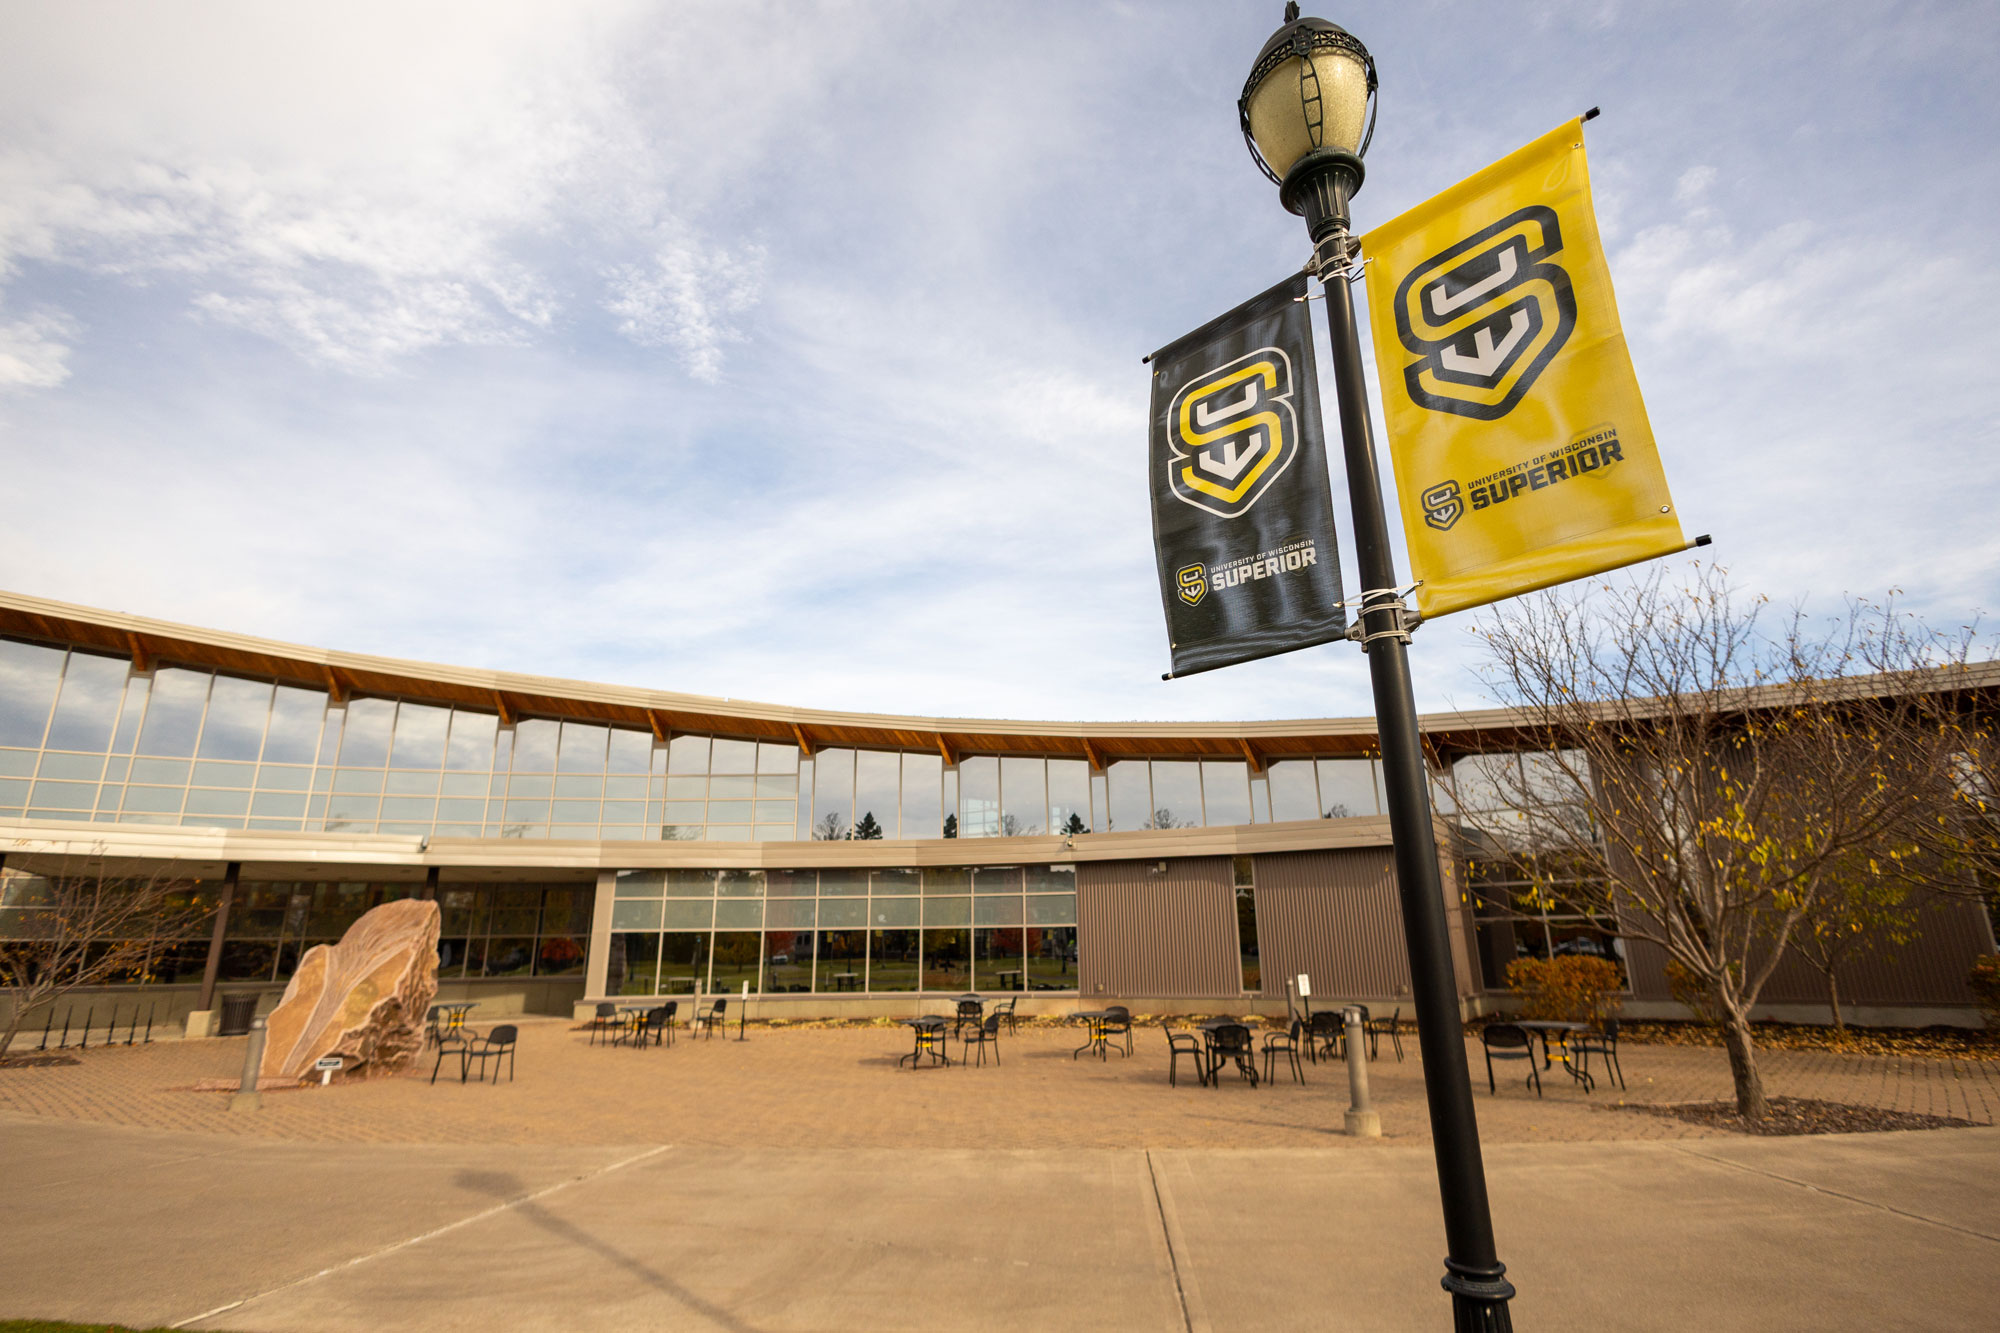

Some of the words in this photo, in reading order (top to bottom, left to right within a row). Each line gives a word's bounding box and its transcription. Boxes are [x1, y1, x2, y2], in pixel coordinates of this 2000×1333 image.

[1467, 460, 1529, 490] UNIVERSITY
[1532, 454, 1547, 466] OF
[1549, 428, 1618, 459] WISCONSIN
[1470, 438, 1625, 511] SUPERIOR
[1211, 556, 1254, 573] UNIVERSITY
[1256, 552, 1267, 560] OF
[1268, 538, 1315, 557] WISCONSIN
[1212, 548, 1317, 590] SUPERIOR
